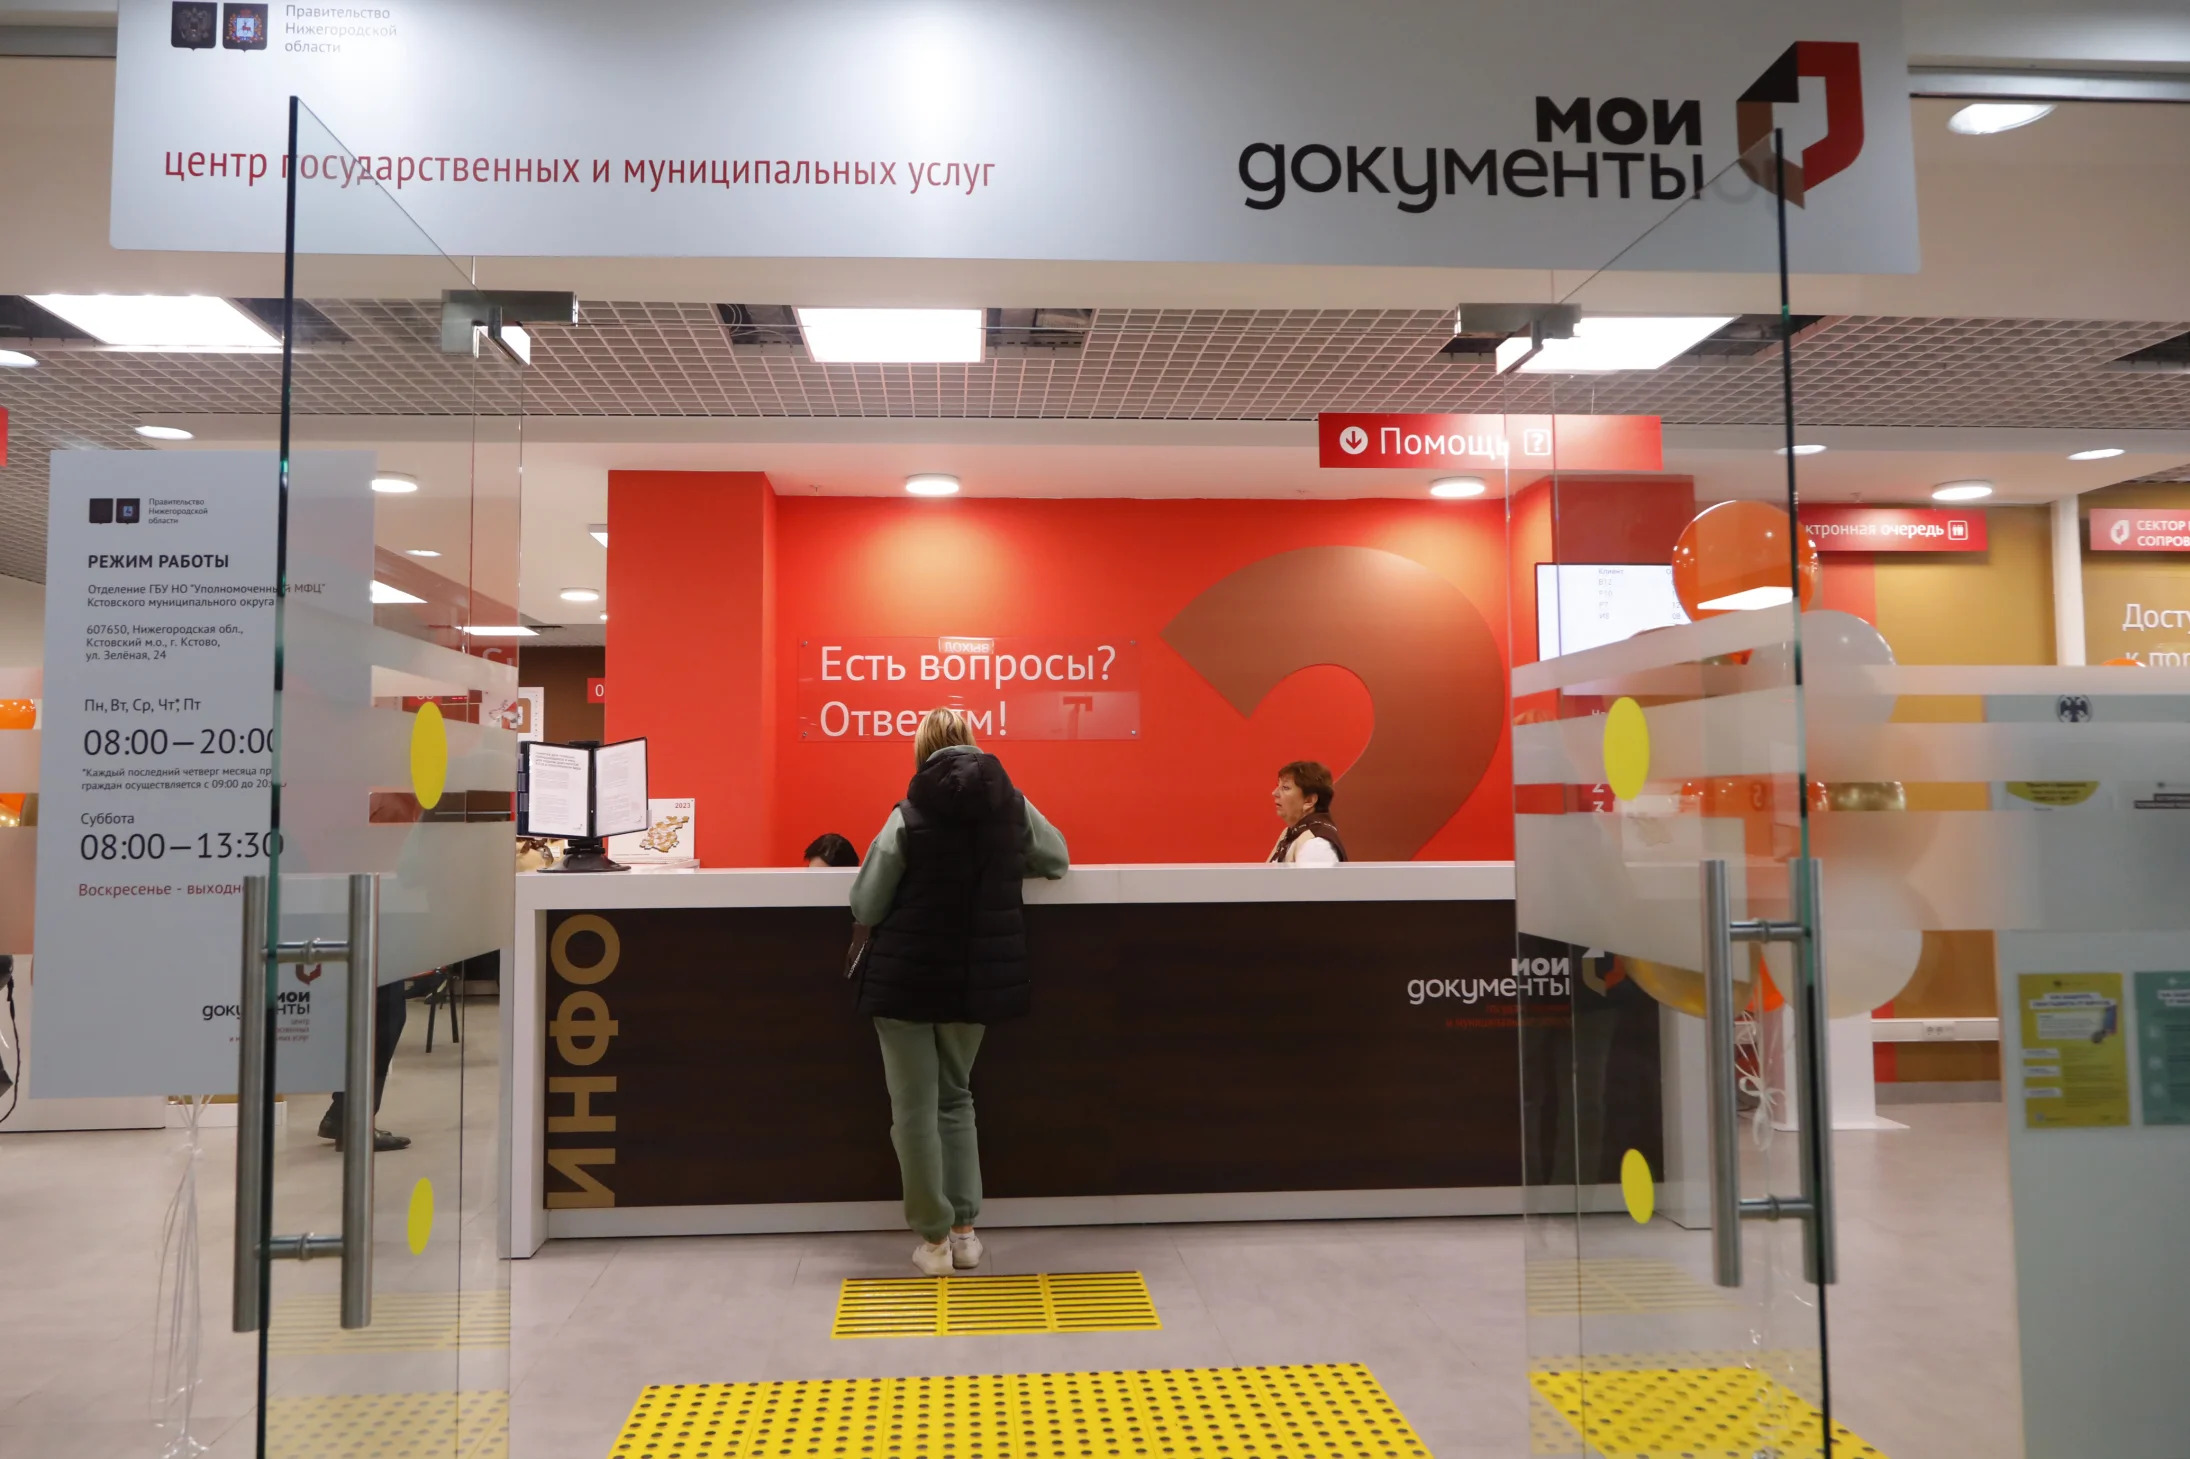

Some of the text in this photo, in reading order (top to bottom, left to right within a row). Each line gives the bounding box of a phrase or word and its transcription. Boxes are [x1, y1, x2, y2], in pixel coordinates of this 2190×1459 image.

[286, 4, 391, 19] Правительство
[285, 22, 397, 37] Нижегородской
[284, 40, 341, 53] области
[1535, 96, 1703, 146] мои
[165, 151, 995, 195] центр государственных и муниципальных услуг
[1238, 142, 1704, 213] документы
[1380, 427, 1508, 460] Помощь
[148, 497, 205, 507] Правительство
[148, 507, 208, 516] Нижегородской
[148, 515, 178, 524] области
[2136, 520, 2186, 531] СЕКТОР
[1805, 523, 1945, 538] ктронная очередь
[88, 554, 229, 568] РЕЖИМ РАБОТЫ
[88, 583, 146, 595] Отделение
[150, 583, 168, 594] ГБУ
[171, 583, 188, 593] НО
[87, 597, 275, 608] Кстовского муниципального округа
[2122, 603, 2190, 634] Дост
[86, 623, 244, 635] 607650, Нижегородская обл.,
[86, 636, 142, 648] Кстовский
[181, 636, 220, 648] Кстово,
[86, 649, 167, 661] ул. Зелёная, 24
[821, 645, 1116, 690] Есть вопросы?
[84, 698, 108, 713] Пн,
[110, 698, 129, 713] Вт,
[133, 699, 154, 714] Ср,
[184, 697, 202, 710] Пт
[820, 701, 1007, 736] Отвем!
[128, 767, 180, 777] последний
[183, 767, 219, 777] четверг
[222, 767, 257, 776] месяца
[81, 781, 123, 791] граждан
[125, 780, 201, 790] осуществляется
[204, 781, 209, 789] с
[211, 779, 239, 789] 09:00
[241, 780, 253, 789] до
[80, 813, 135, 829] Суббота
[79, 883, 172, 898] Воскресенье
[187, 883, 244, 895] выходн
[546, 913, 621, 1209] ИНФО
